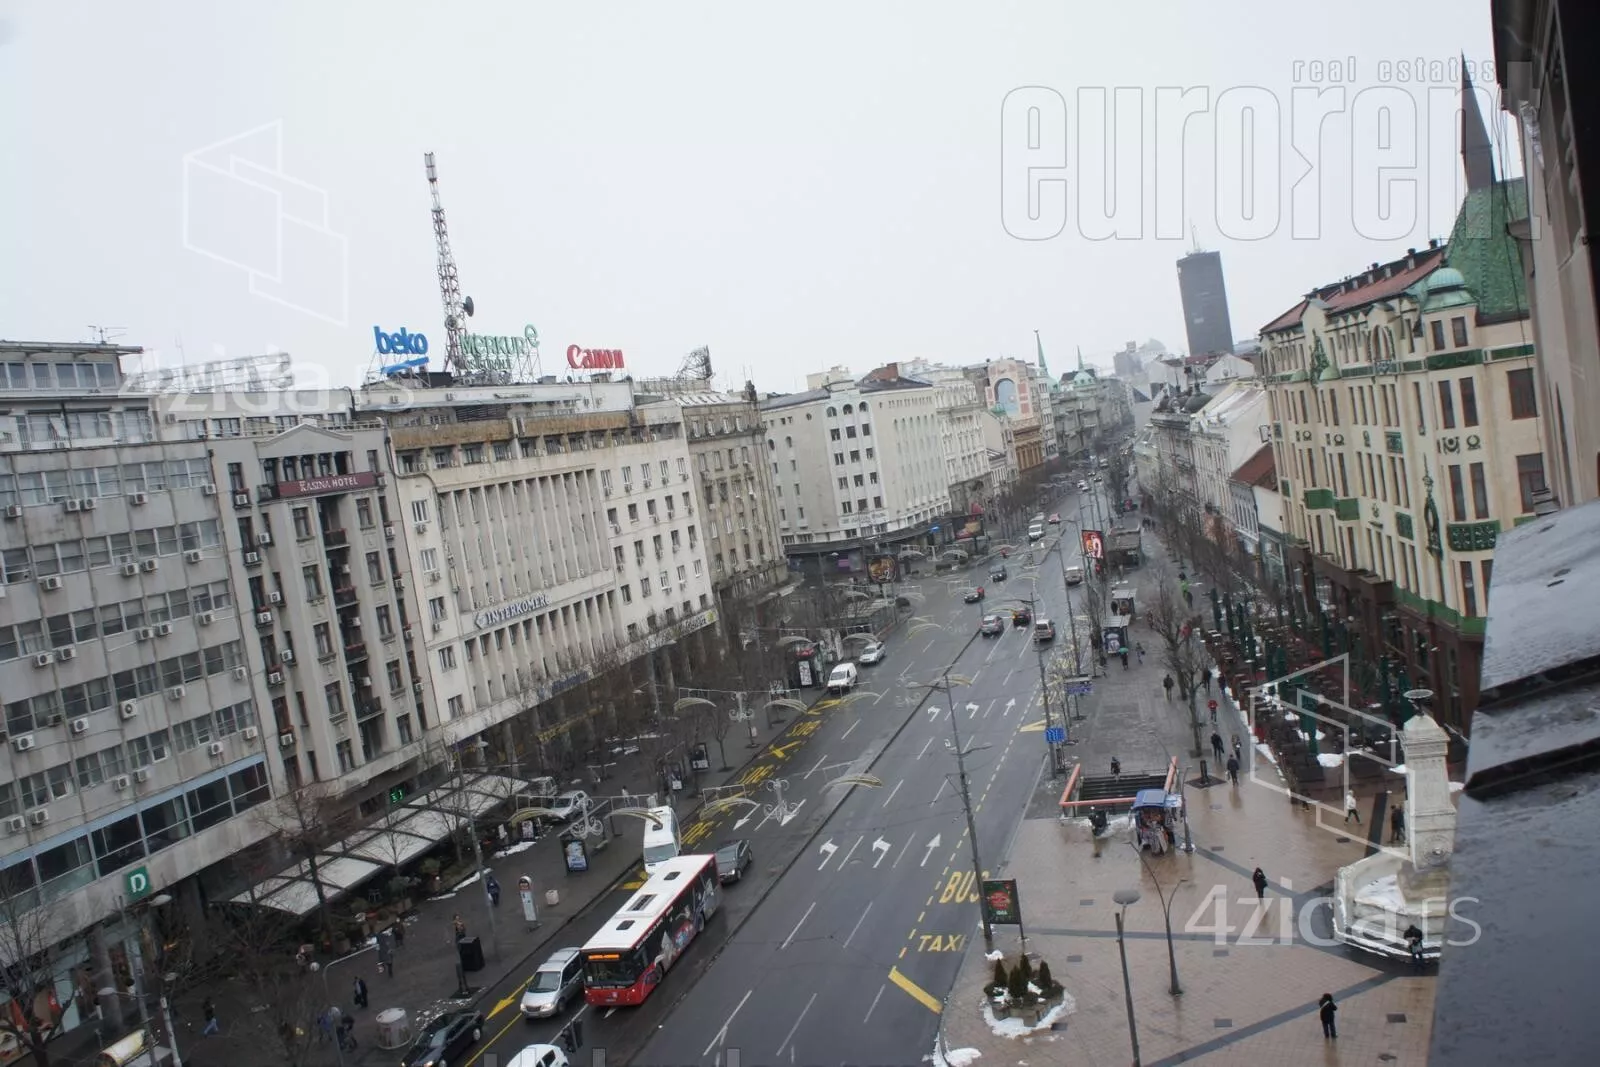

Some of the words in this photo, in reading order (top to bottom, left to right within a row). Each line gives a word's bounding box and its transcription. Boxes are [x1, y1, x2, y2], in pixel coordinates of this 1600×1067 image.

[373, 325, 429, 355] beko
[566, 344, 625, 369] Canon
[332, 476, 358, 488] HOTEL
[130, 873, 147, 893] D
[918, 934, 968, 952] TAXI
